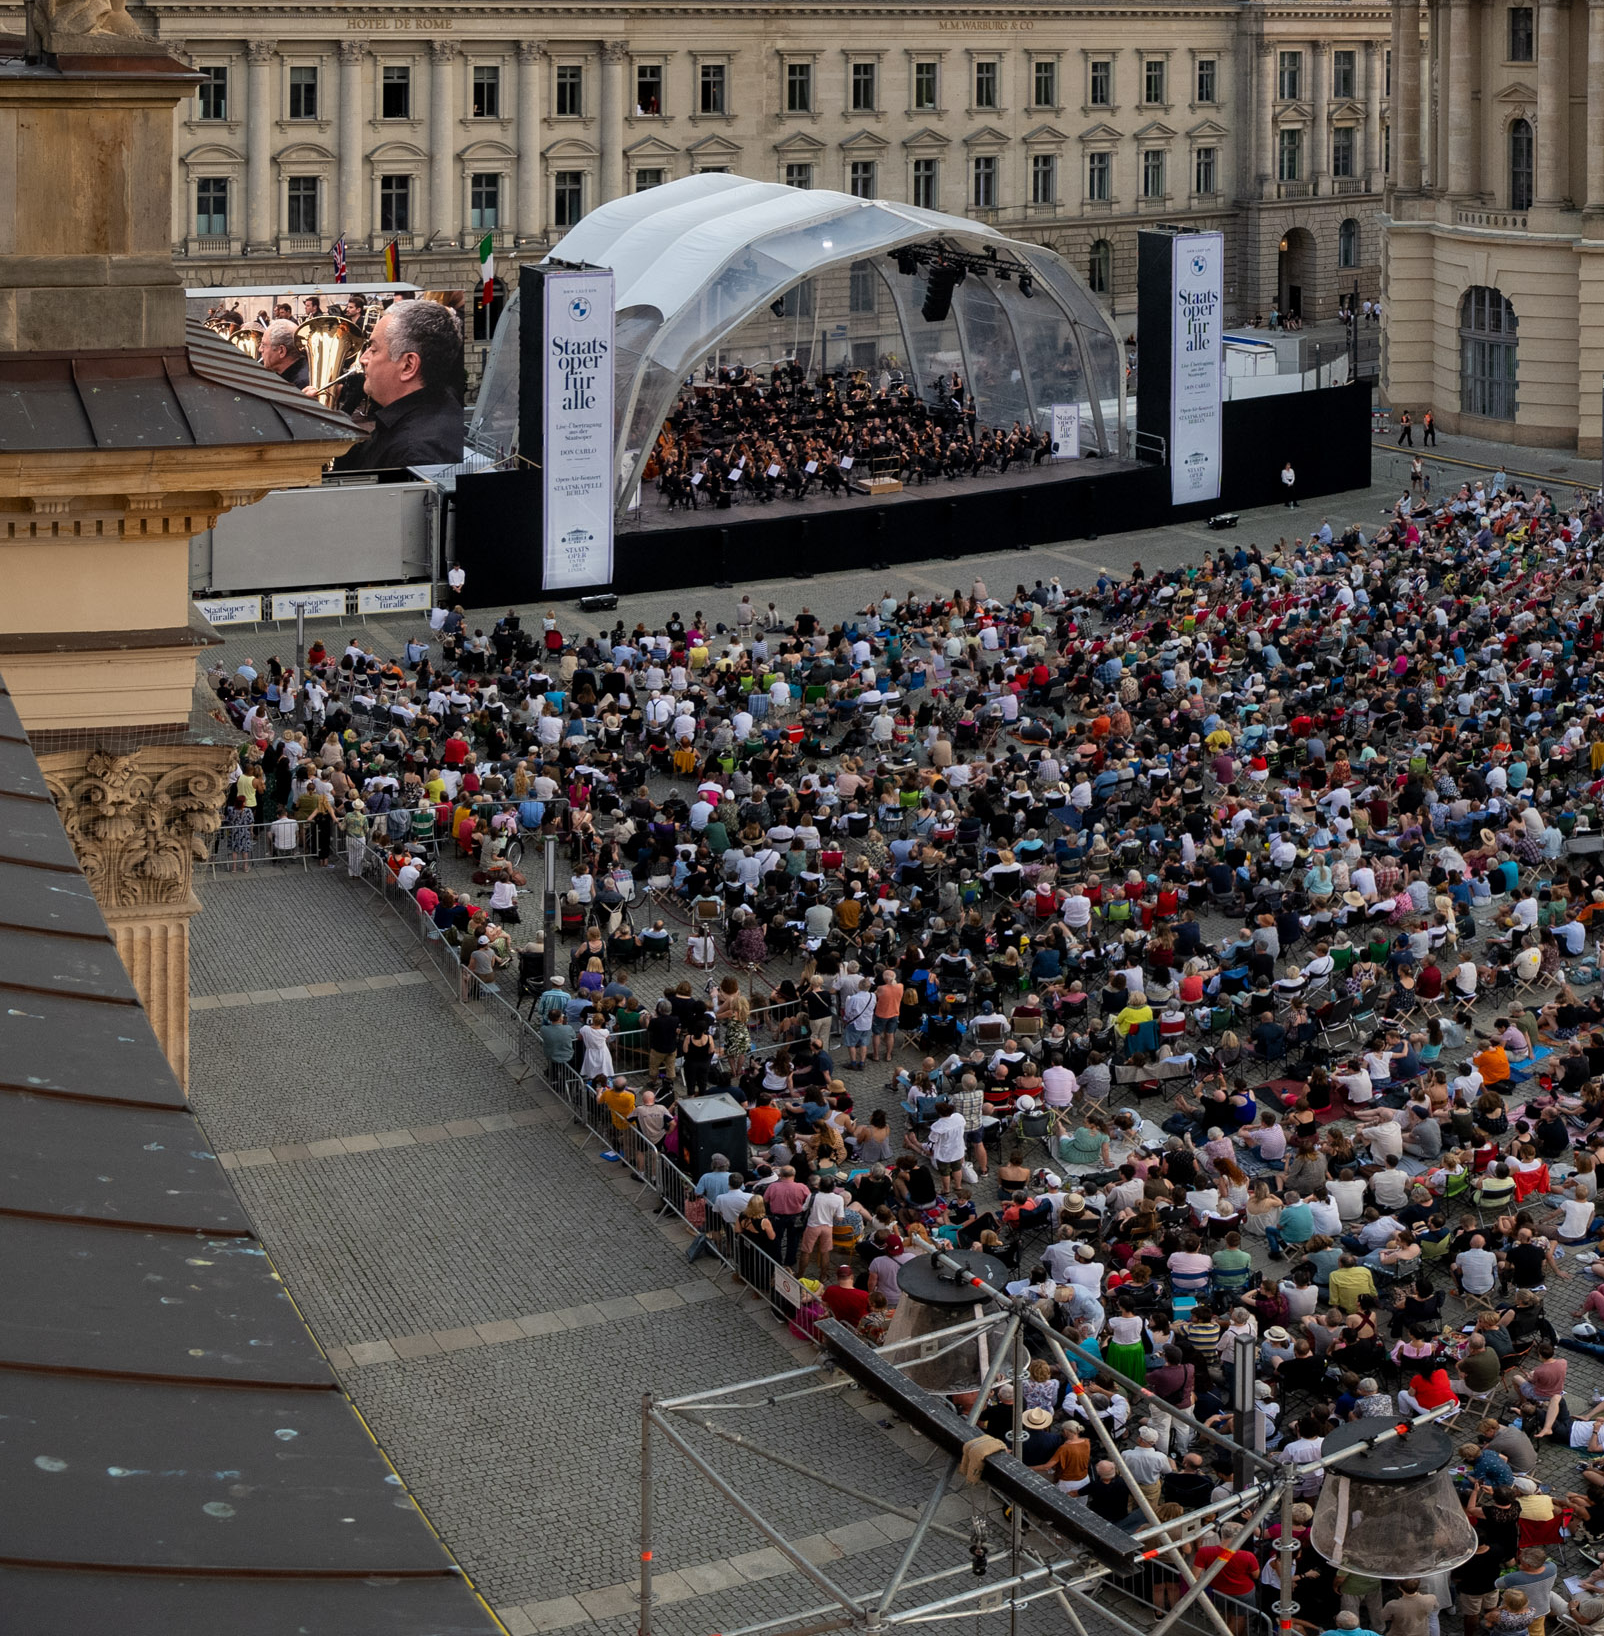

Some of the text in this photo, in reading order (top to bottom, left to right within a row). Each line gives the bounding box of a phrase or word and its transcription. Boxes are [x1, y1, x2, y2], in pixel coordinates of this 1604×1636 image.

[1179, 288, 1218, 306] Staats
[1183, 304, 1215, 321] oper
[1187, 319, 1209, 334] für
[552, 336, 608, 356] Staats
[1186, 334, 1210, 352] alle
[558, 355, 603, 375] oper
[564, 371, 595, 390] für
[562, 390, 596, 410] alle
[374, 592, 415, 603] Staatsoper
[203, 604, 245, 616] Staatsoper
